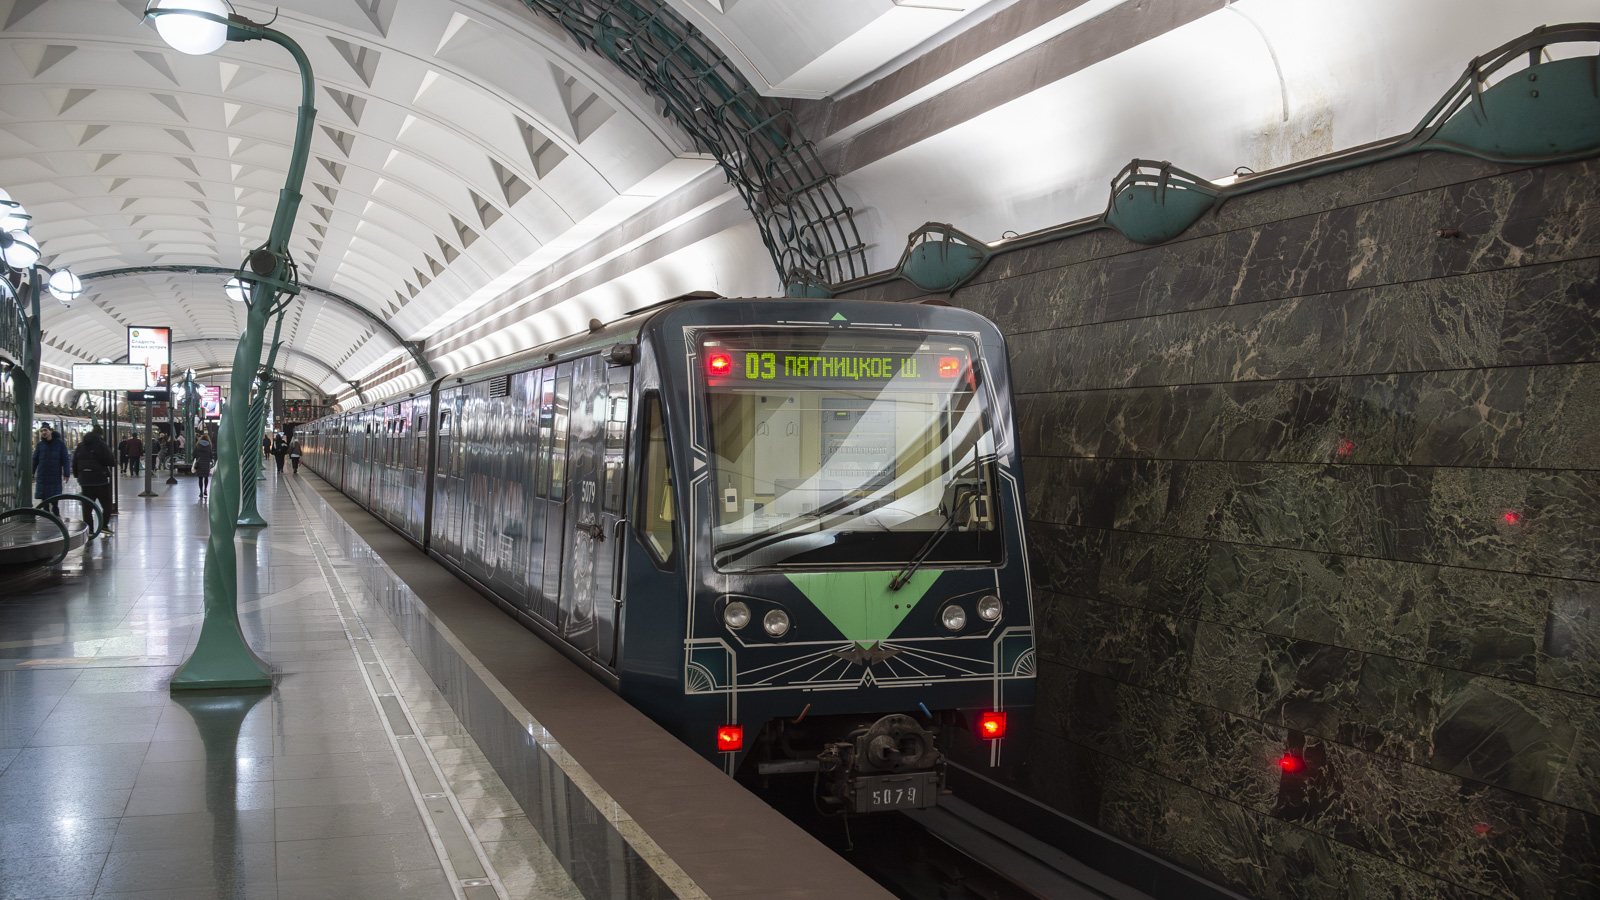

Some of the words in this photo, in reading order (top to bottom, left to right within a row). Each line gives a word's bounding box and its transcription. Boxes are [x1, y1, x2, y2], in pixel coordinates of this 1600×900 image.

[745, 352, 776, 379] 03
[784, 355, 892, 381] ПЯТНИЦКОЕ
[901, 357, 921, 378] Ш.
[581, 480, 596, 504] 5079
[873, 787, 917, 805] 5079
